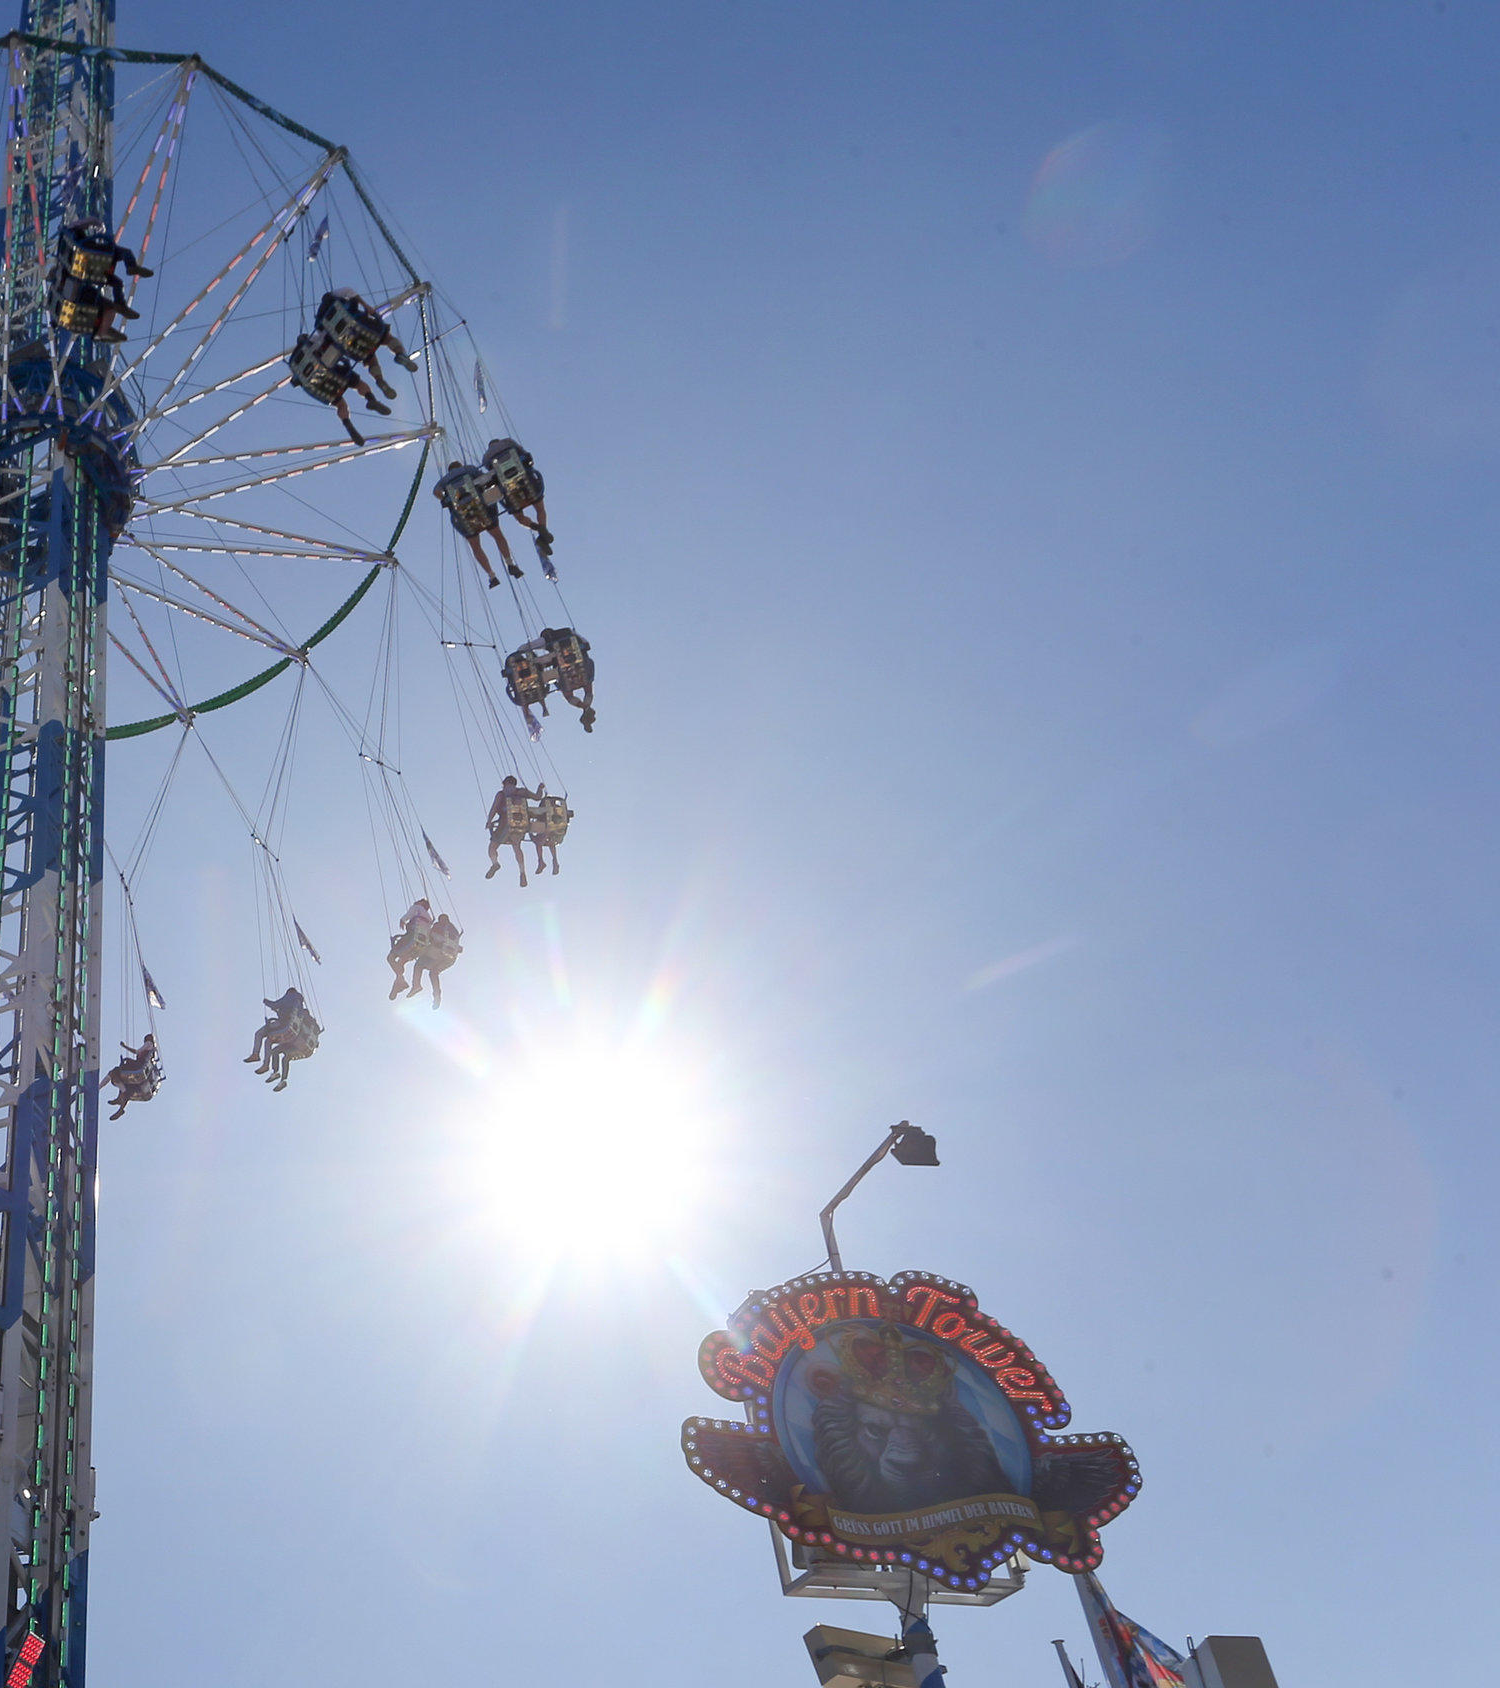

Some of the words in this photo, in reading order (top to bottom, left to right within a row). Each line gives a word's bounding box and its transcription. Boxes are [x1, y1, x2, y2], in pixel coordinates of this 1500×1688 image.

[715, 1287, 880, 1387] Bayern
[906, 1286, 1052, 1412] Tower
[873, 1519, 903, 1535] GOTT
[904, 1517, 920, 1532] IM
[921, 1507, 964, 1530] HIMMEL
[963, 1502, 988, 1519] DER
[987, 1501, 1036, 1520] BAYERN
